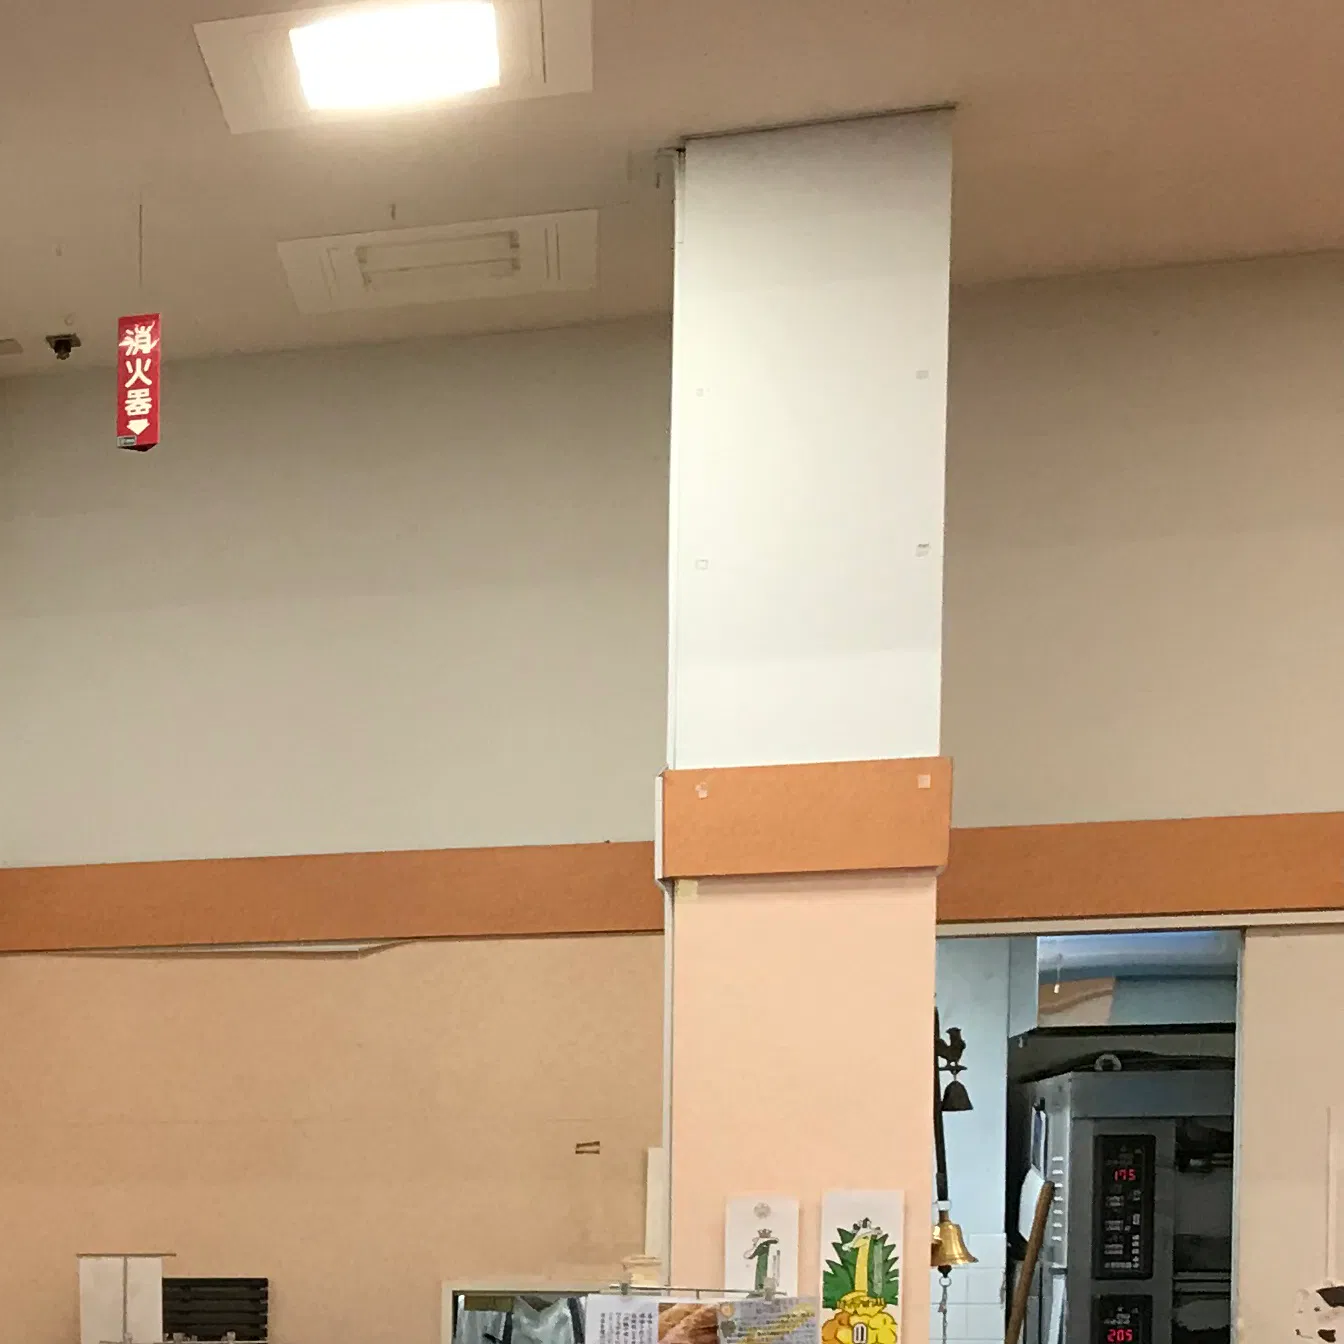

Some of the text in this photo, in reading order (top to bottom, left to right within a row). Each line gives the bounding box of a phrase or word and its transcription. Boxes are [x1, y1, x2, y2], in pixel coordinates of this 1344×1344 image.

[119, 321, 160, 416] 消火器
[1113, 1168, 1136, 1181] 175
[1107, 1328, 1133, 1343] 205
